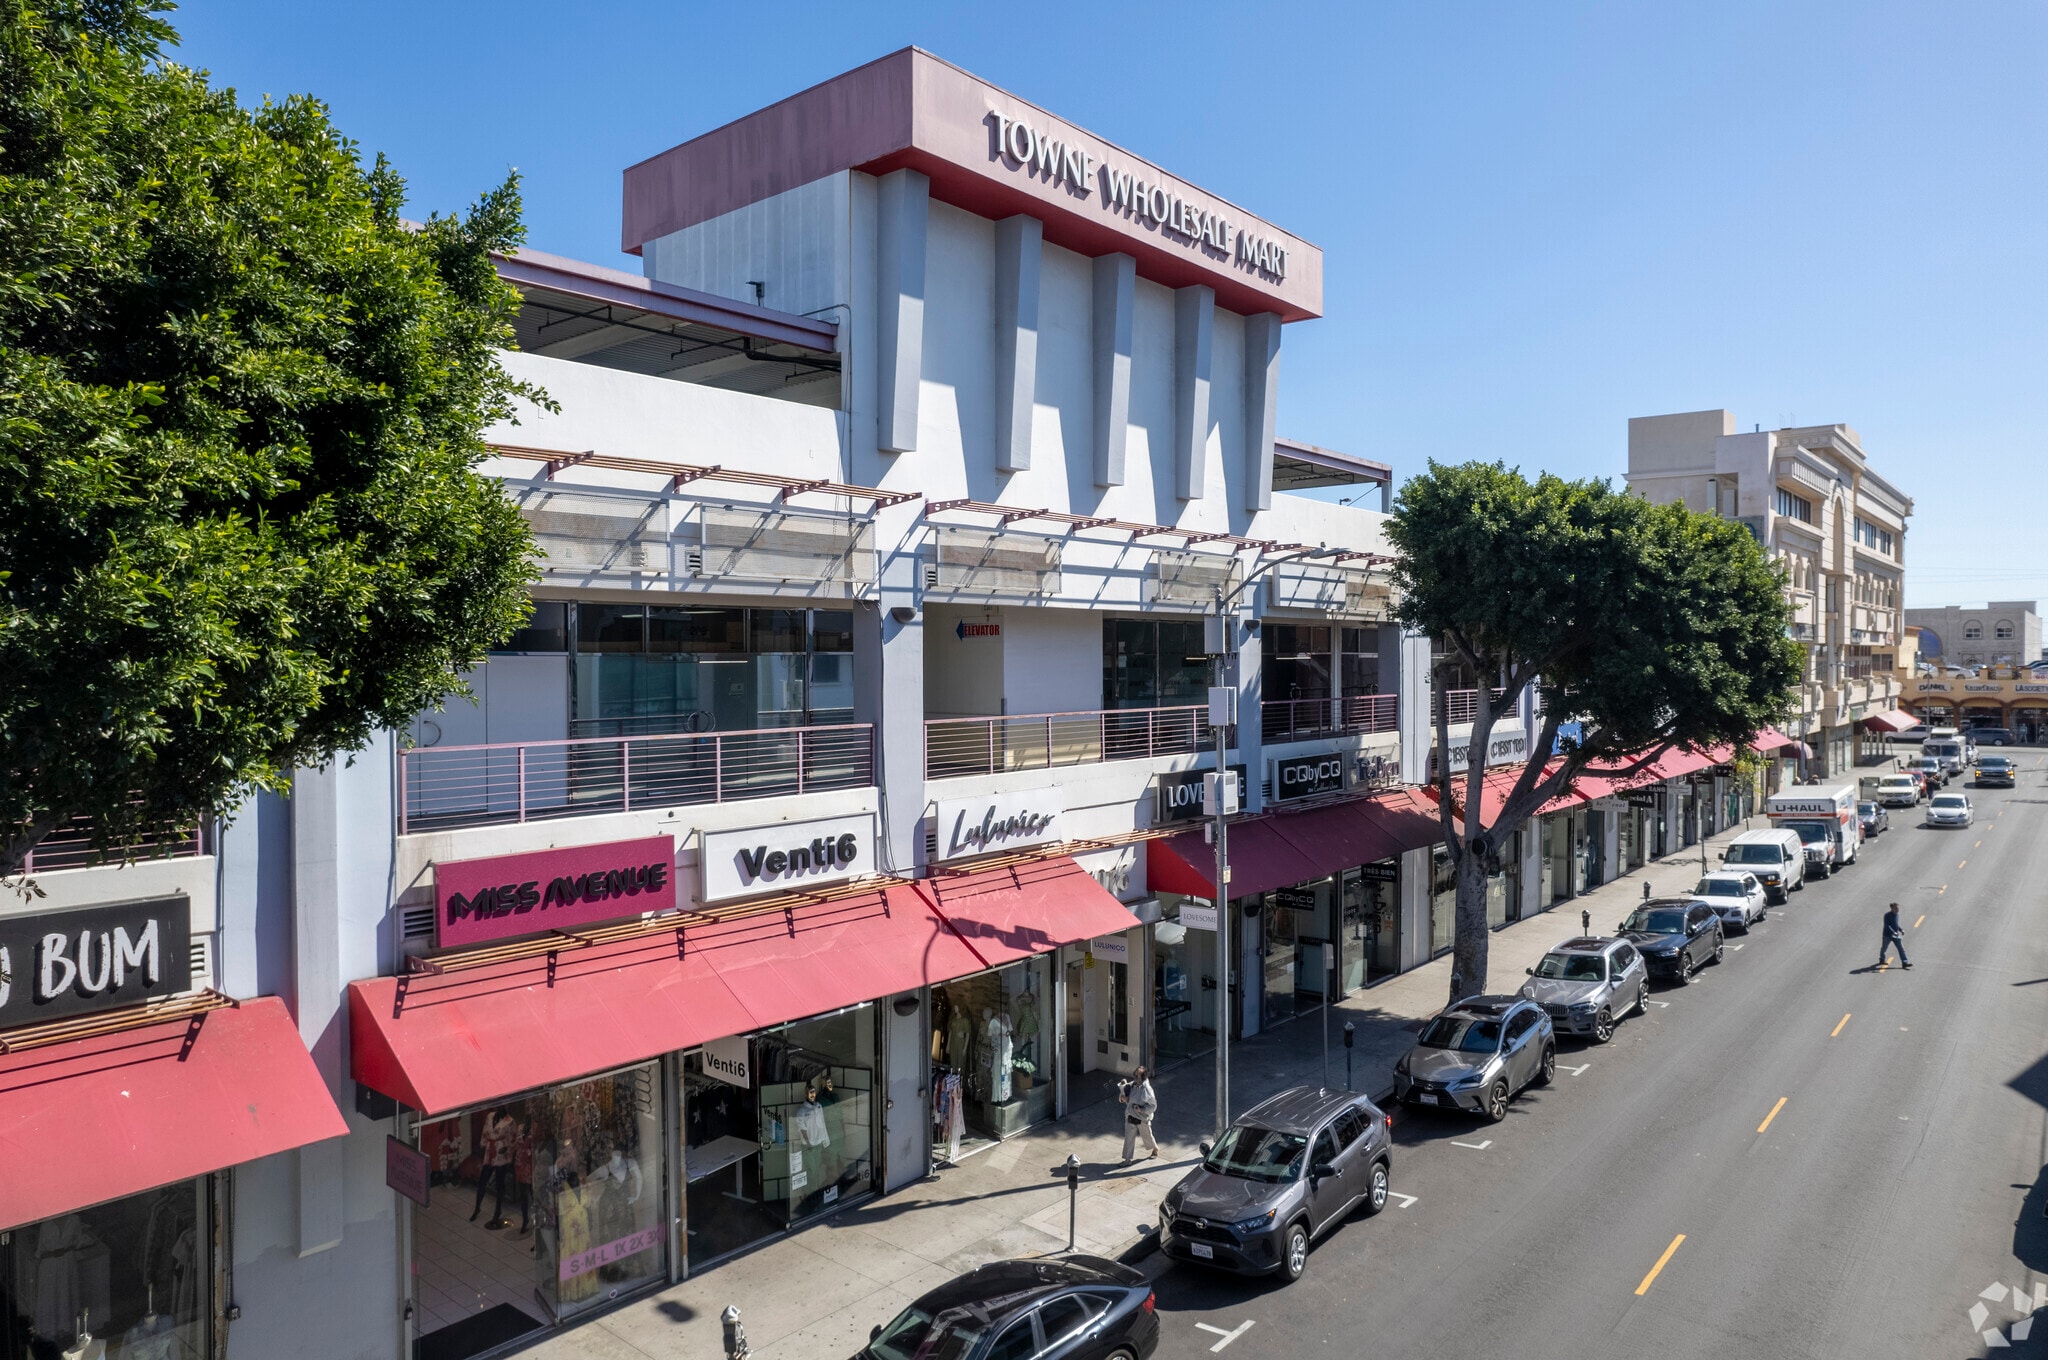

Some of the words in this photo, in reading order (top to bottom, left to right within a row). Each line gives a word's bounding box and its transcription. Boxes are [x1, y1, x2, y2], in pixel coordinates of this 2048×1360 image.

[989, 109, 1095, 193] TOWNE
[1103, 162, 1234, 256] WHOLESALE
[1240, 229, 1290, 279] MART
[963, 624, 1000, 636] ELEVATOR
[1283, 760, 1341, 784] CQbyCQ
[1168, 776, 1245, 808] LOVEE
[1775, 804, 1825, 812] U-HAUL
[952, 804, 1056, 850] Lulunico
[738, 832, 857, 878] Venti6
[1380, 869, 1396, 877] BIEN
[454, 880, 540, 918] MISS
[547, 862, 669, 904] AVENUE
[1277, 892, 1315, 905] CQbyCQ
[1183, 913, 1217, 924] LOVESOME
[1094, 941, 1126, 952] LULUNICO
[41, 919, 159, 999] BUM
[705, 1052, 746, 1078] Venti6
[614, 1241, 627, 1257] 1X
[629, 1235, 645, 1252] 2X
